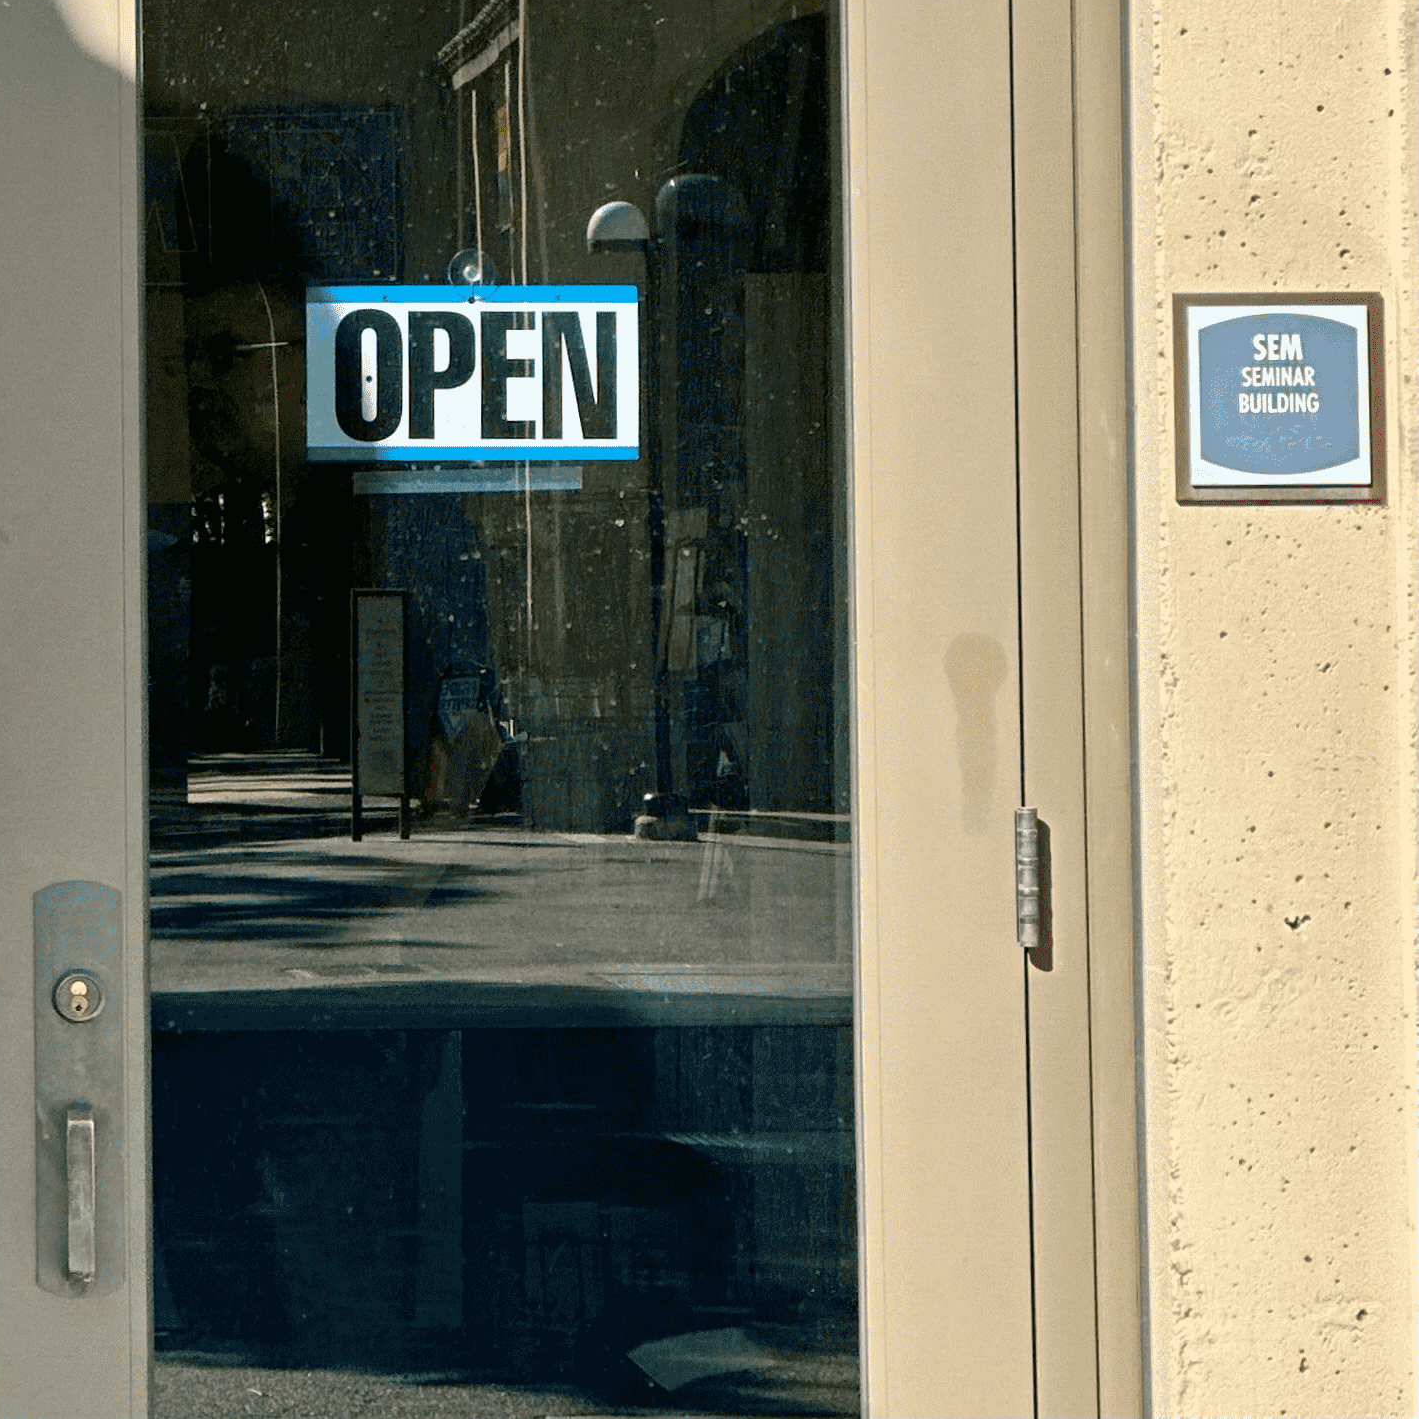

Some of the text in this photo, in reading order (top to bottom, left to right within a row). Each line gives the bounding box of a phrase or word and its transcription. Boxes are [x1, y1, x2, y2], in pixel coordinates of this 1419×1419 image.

[1251, 333, 1304, 361] SEM
[334, 308, 618, 442] OPEN
[1240, 365, 1316, 387] SEMINAR
[1238, 392, 1320, 414] BUILDING
